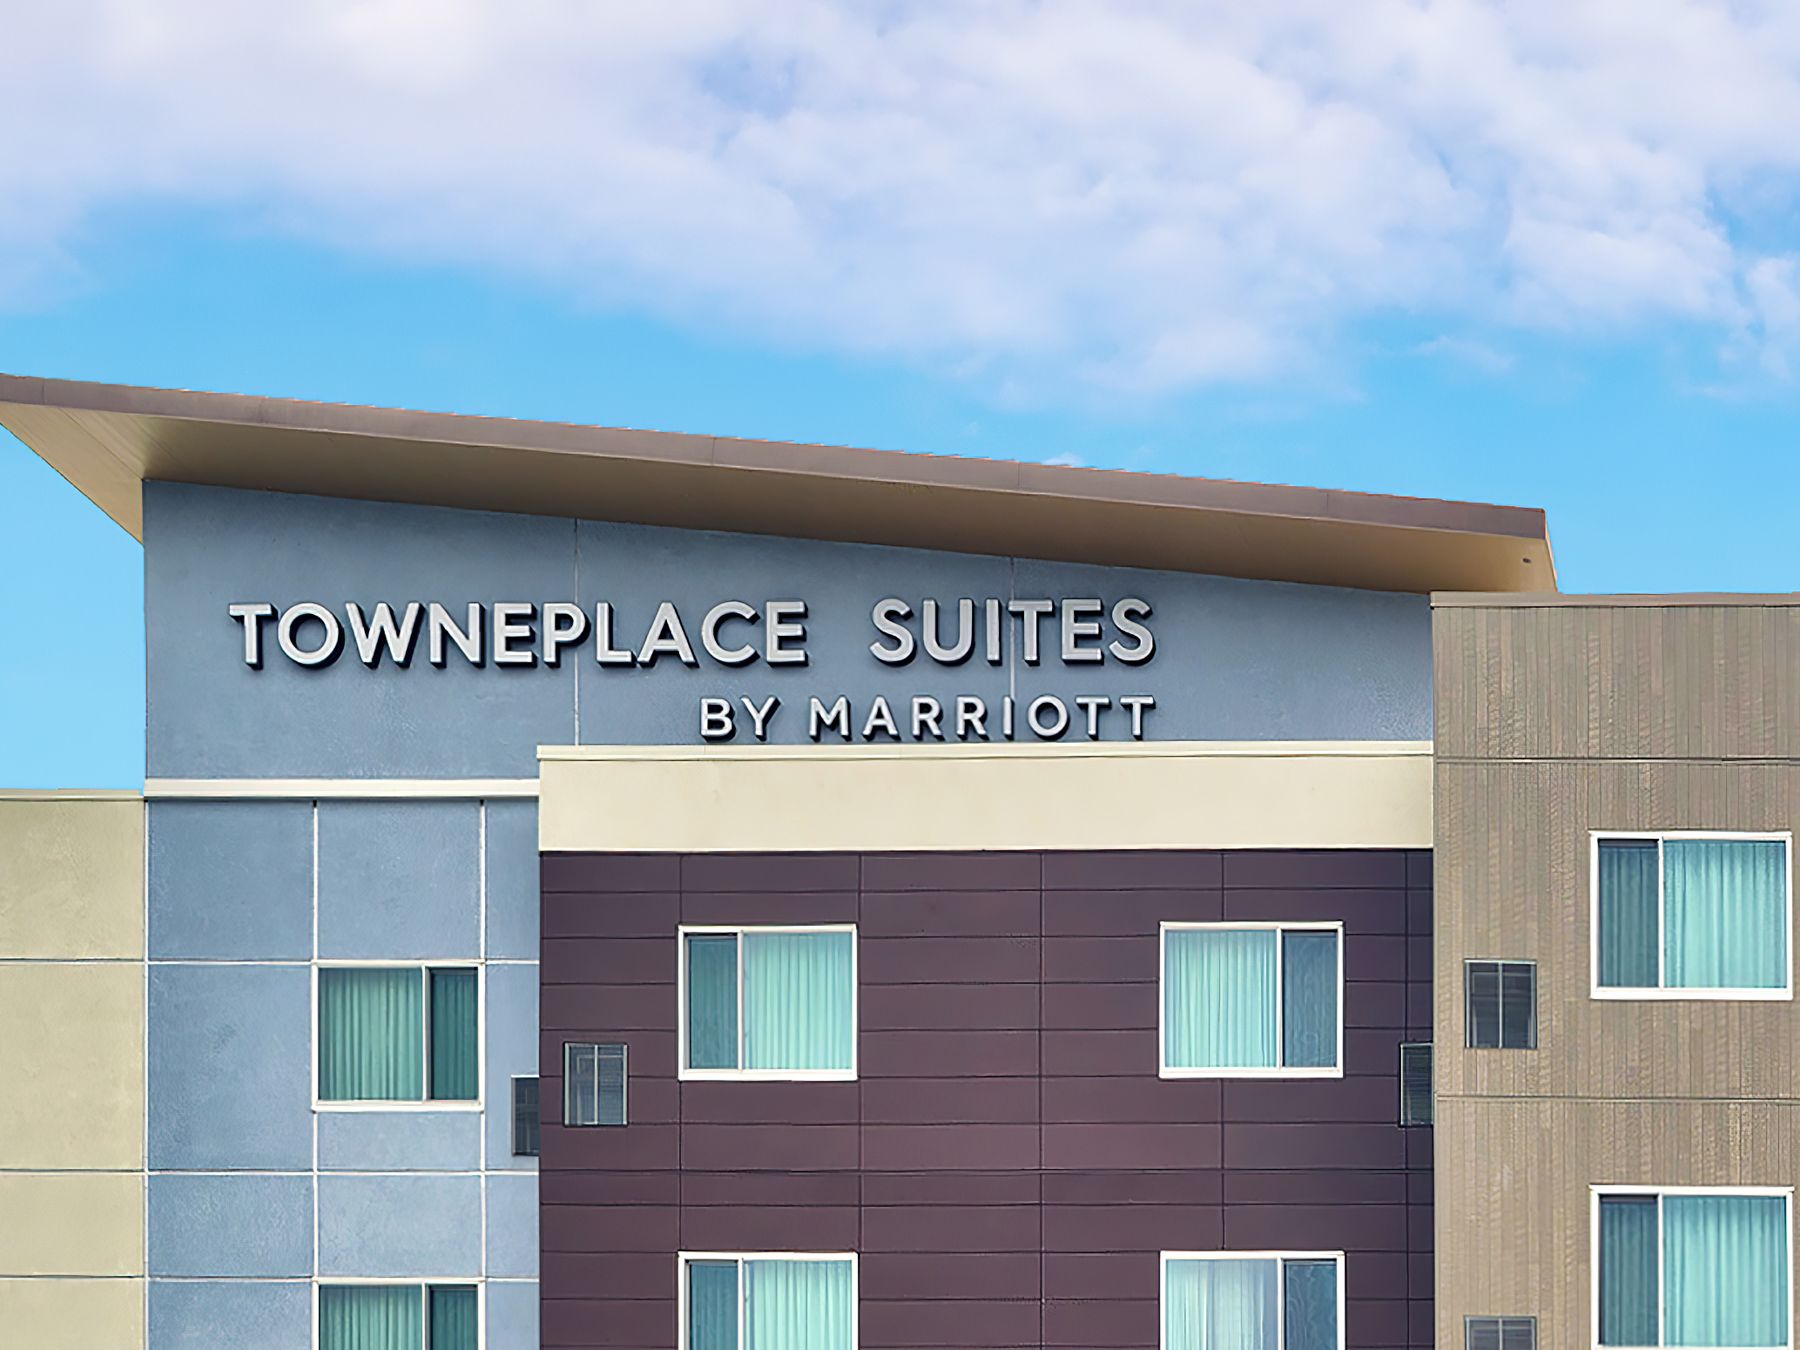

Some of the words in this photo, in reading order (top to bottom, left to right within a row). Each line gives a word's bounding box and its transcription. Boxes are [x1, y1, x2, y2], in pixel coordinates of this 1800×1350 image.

[229, 600, 807, 668] TOWNEPLACE
[870, 599, 1157, 665] SUITES
[701, 697, 779, 740] BY
[809, 695, 1155, 740] MARRIOTT
